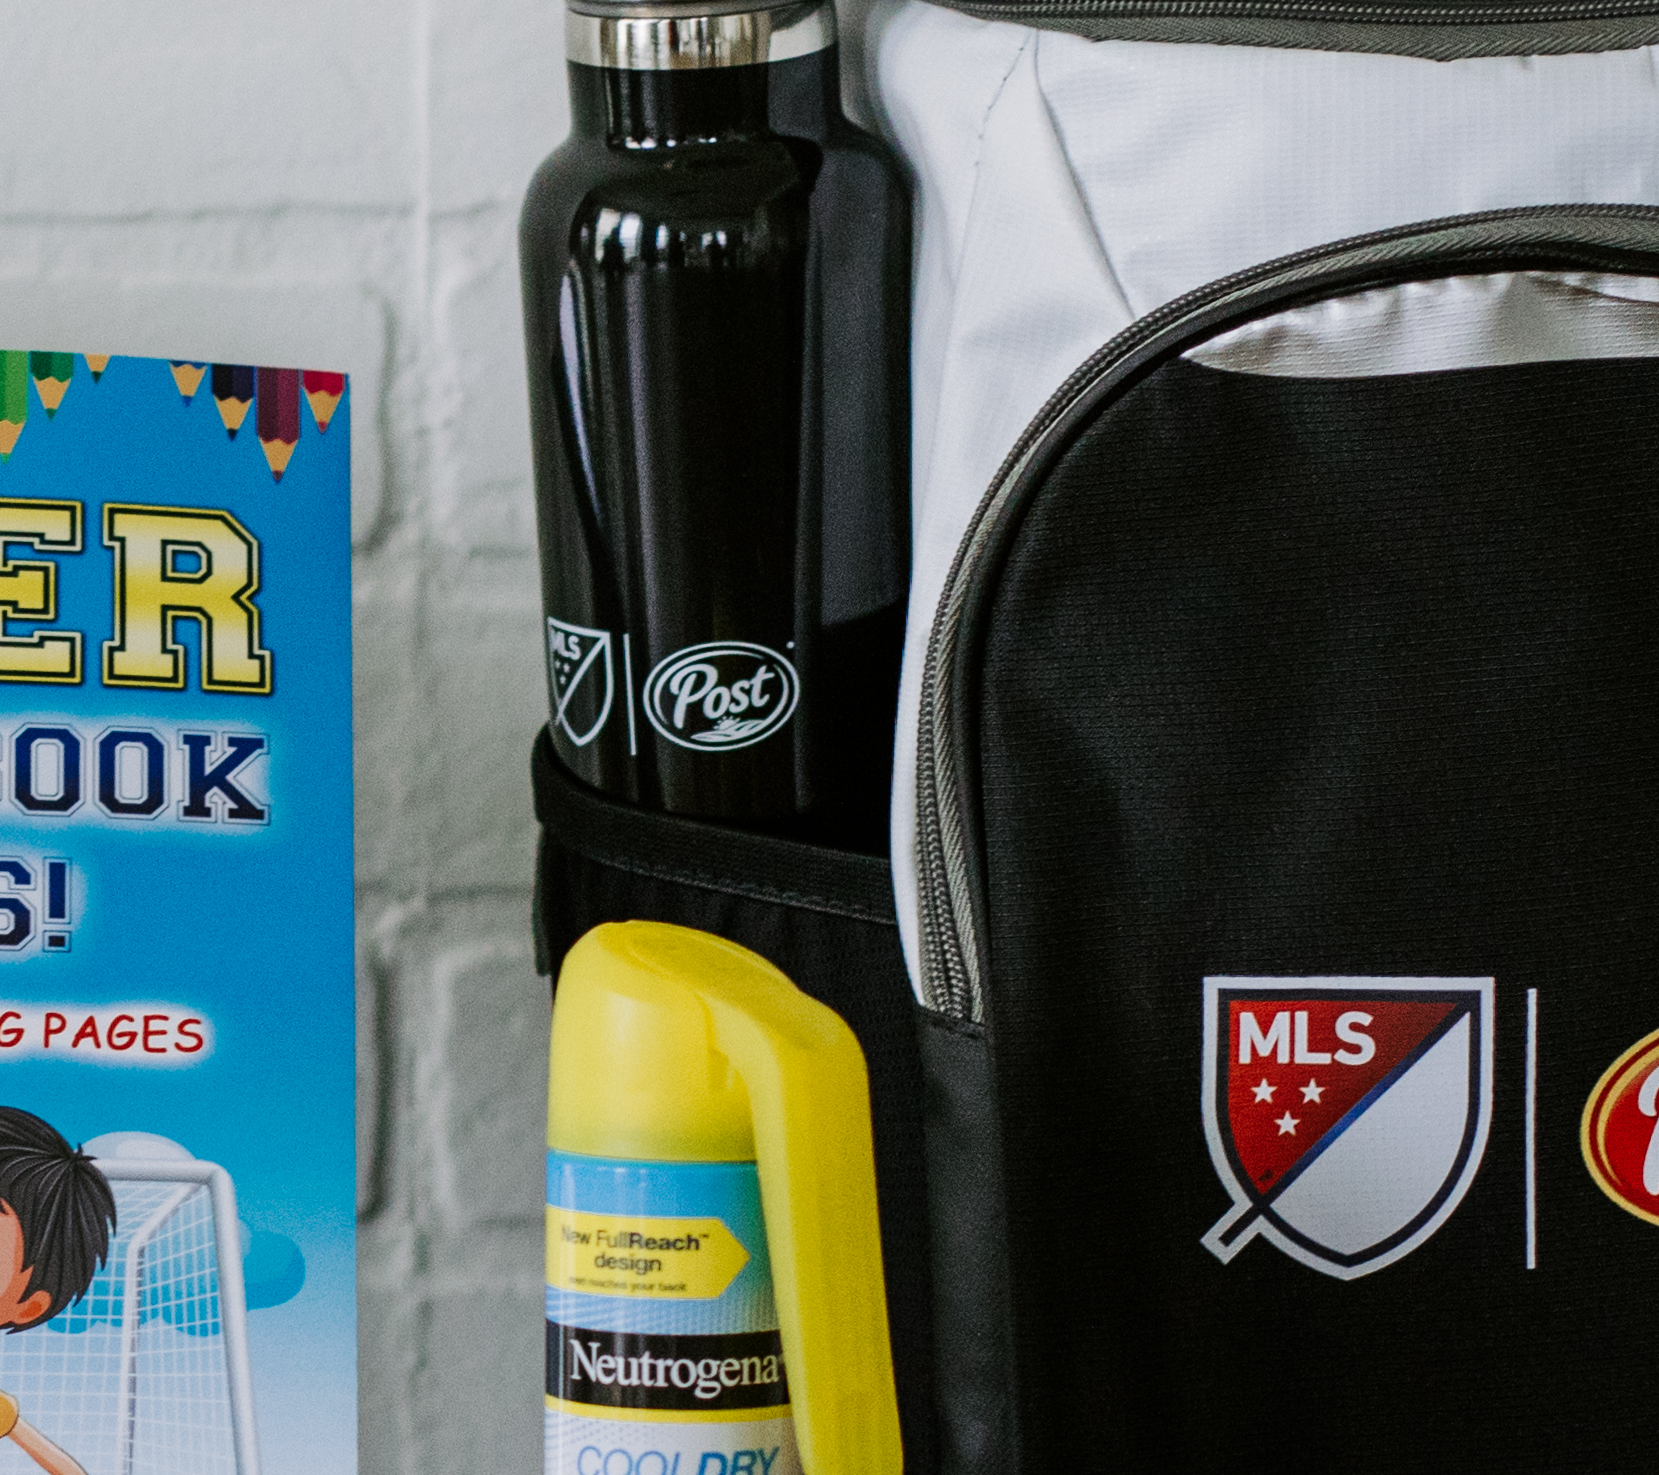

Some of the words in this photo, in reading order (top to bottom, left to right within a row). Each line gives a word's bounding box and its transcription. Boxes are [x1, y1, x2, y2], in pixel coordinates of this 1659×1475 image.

[669, 663, 775, 729] Post
[41, 1012, 206, 1056] PAGES
[1236, 1010, 1377, 1067] MLS
[594, 1253, 662, 1275] design
[569, 1339, 780, 1400] Neutrogena
